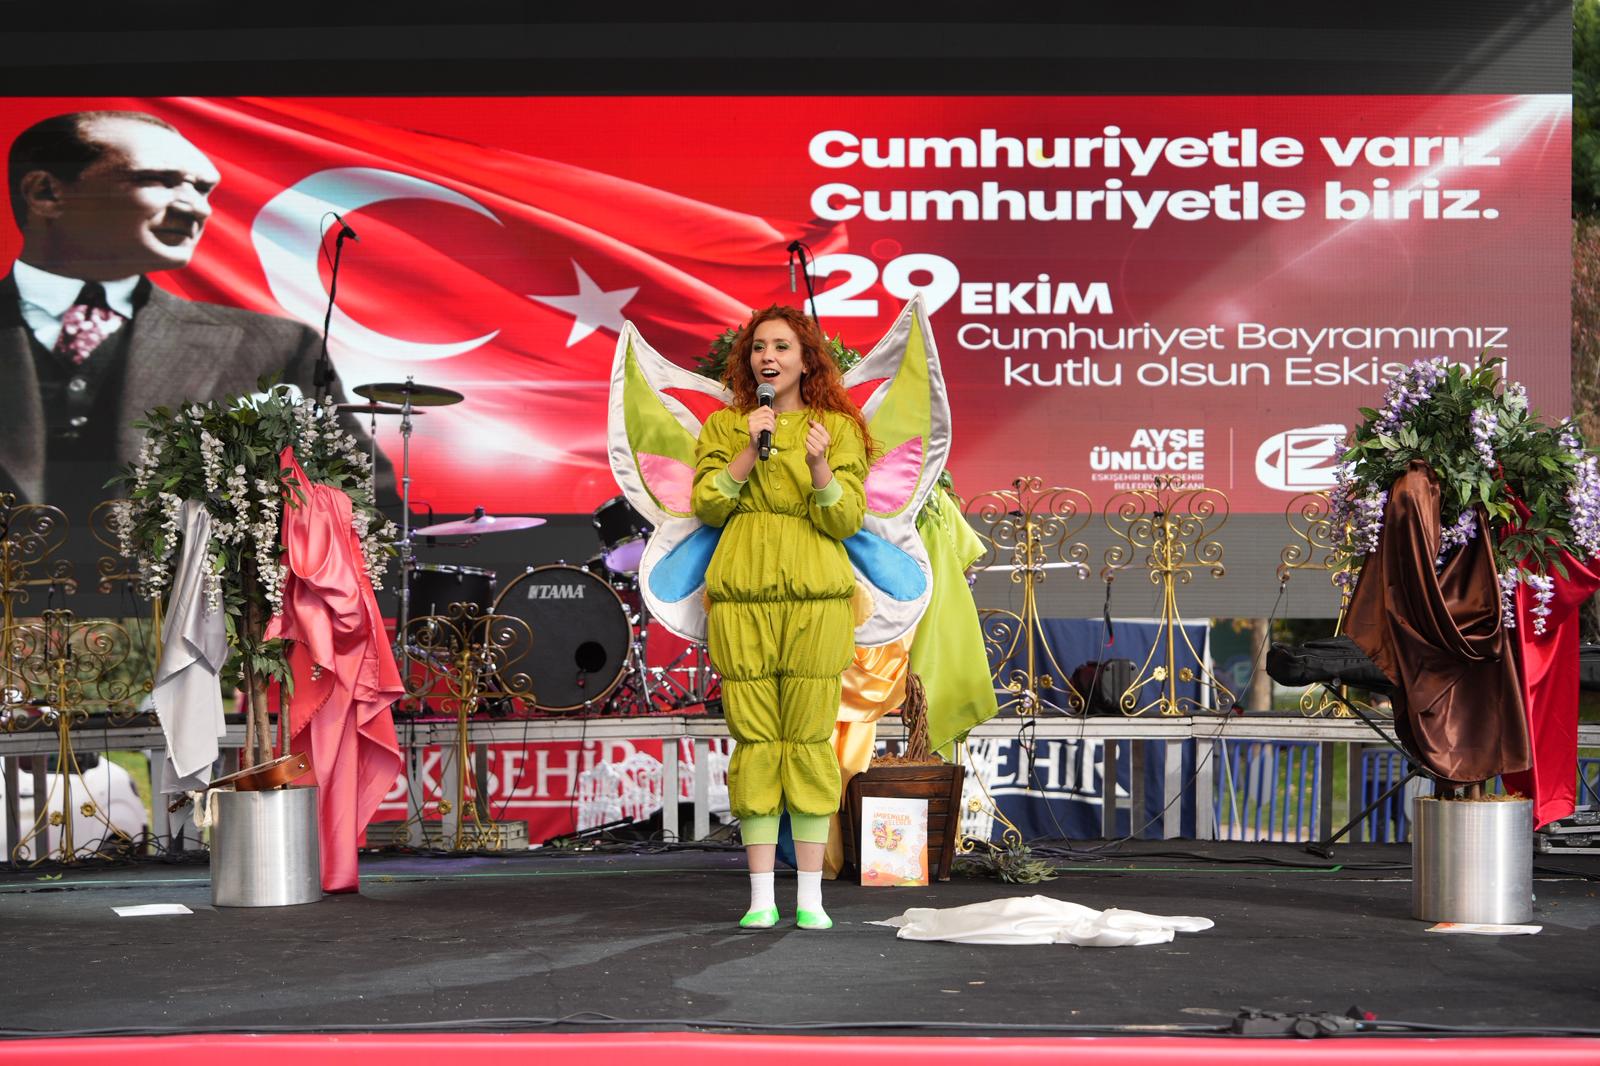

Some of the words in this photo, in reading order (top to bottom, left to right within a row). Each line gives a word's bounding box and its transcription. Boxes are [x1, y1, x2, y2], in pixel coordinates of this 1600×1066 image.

[808, 125, 1304, 176] Cumhuriyetle
[1319, 136, 1501, 167] varız
[810, 178, 1306, 229] Cumhuriyetle
[1325, 178, 1499, 220] biriz.
[804, 253, 960, 317] 29
[961, 273, 1113, 315] EKİM
[957, 322, 1224, 355] Cumhuriyet
[1237, 322, 1509, 355] Bayramımız
[1004, 356, 1122, 387] kutlu
[1136, 356, 1270, 386] olsun
[1130, 428, 1205, 451] AYŞE
[1089, 446, 1205, 471] ÜNLÜCE
[539, 584, 585, 599] TAMA
